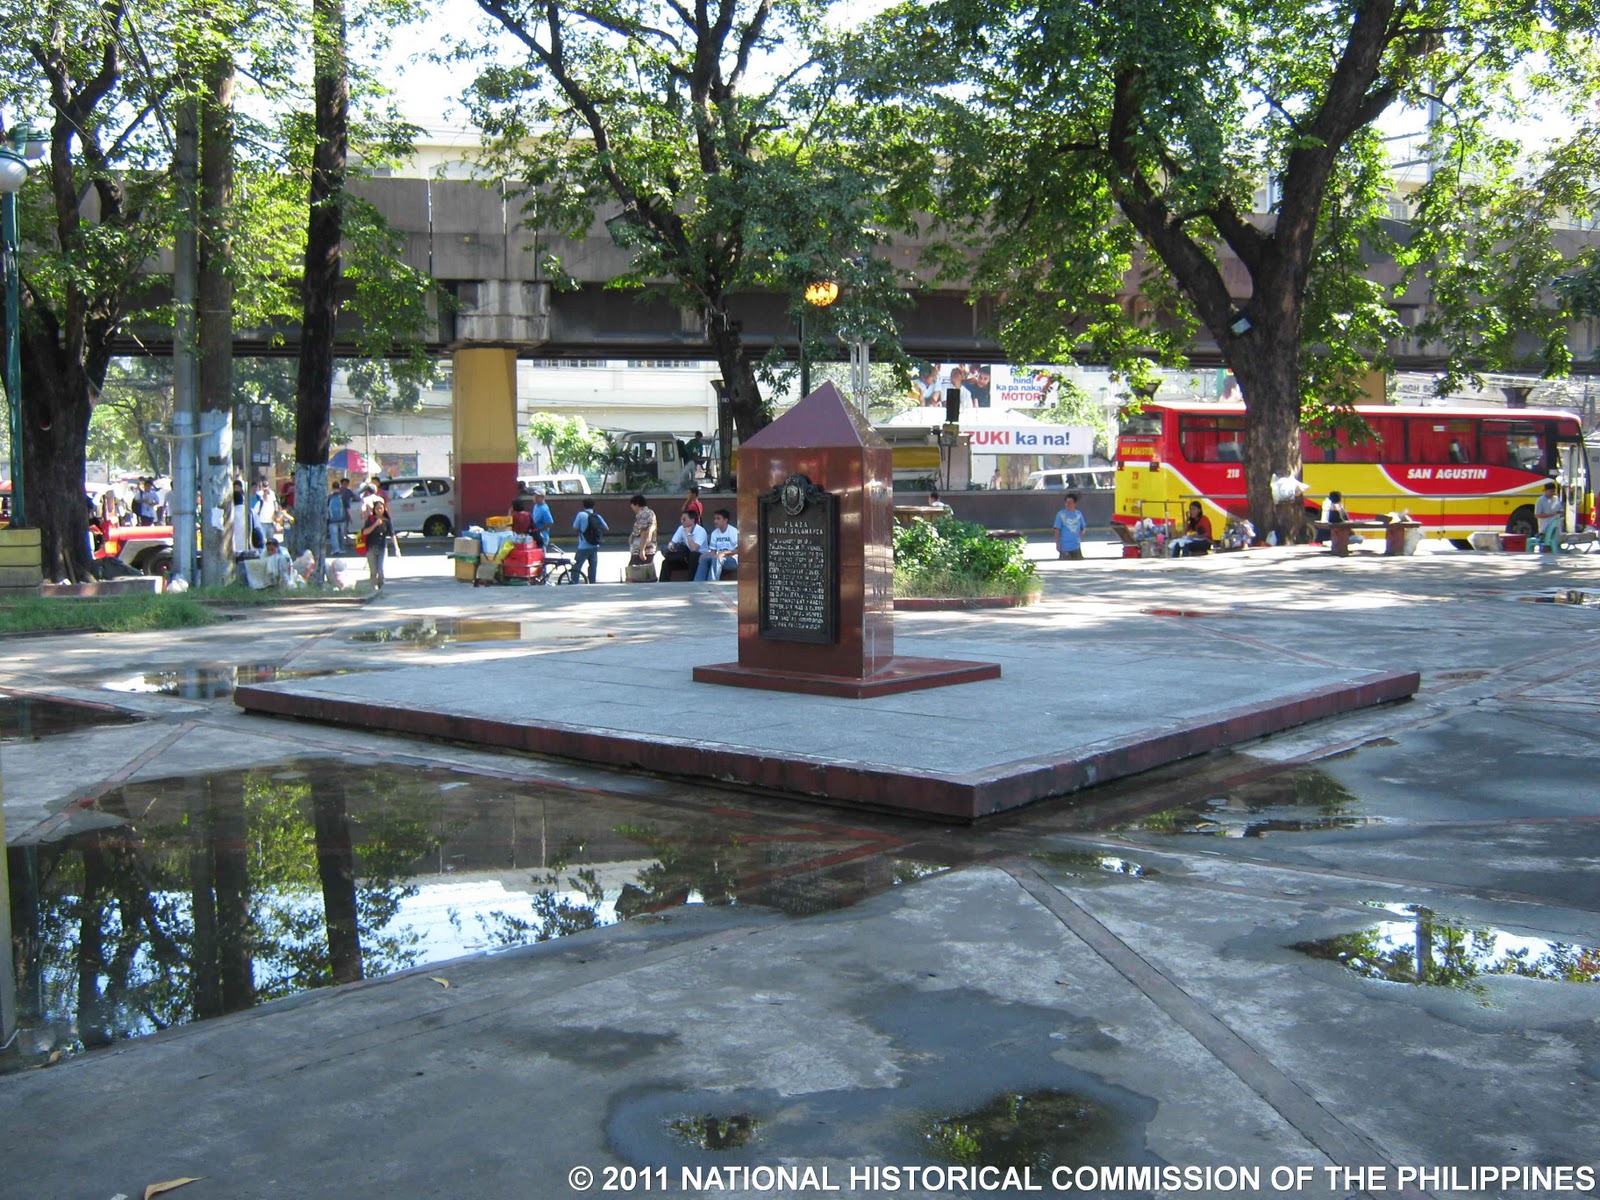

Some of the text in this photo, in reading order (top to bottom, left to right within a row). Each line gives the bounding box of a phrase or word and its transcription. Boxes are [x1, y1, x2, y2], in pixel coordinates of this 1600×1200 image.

[1001, 392, 1041, 401] MOTOR
[960, 431, 1070, 446] ZUKI ka na!
[1226, 468, 1240, 479] 218
[1407, 468, 1487, 479] SAN AGUSTIN
